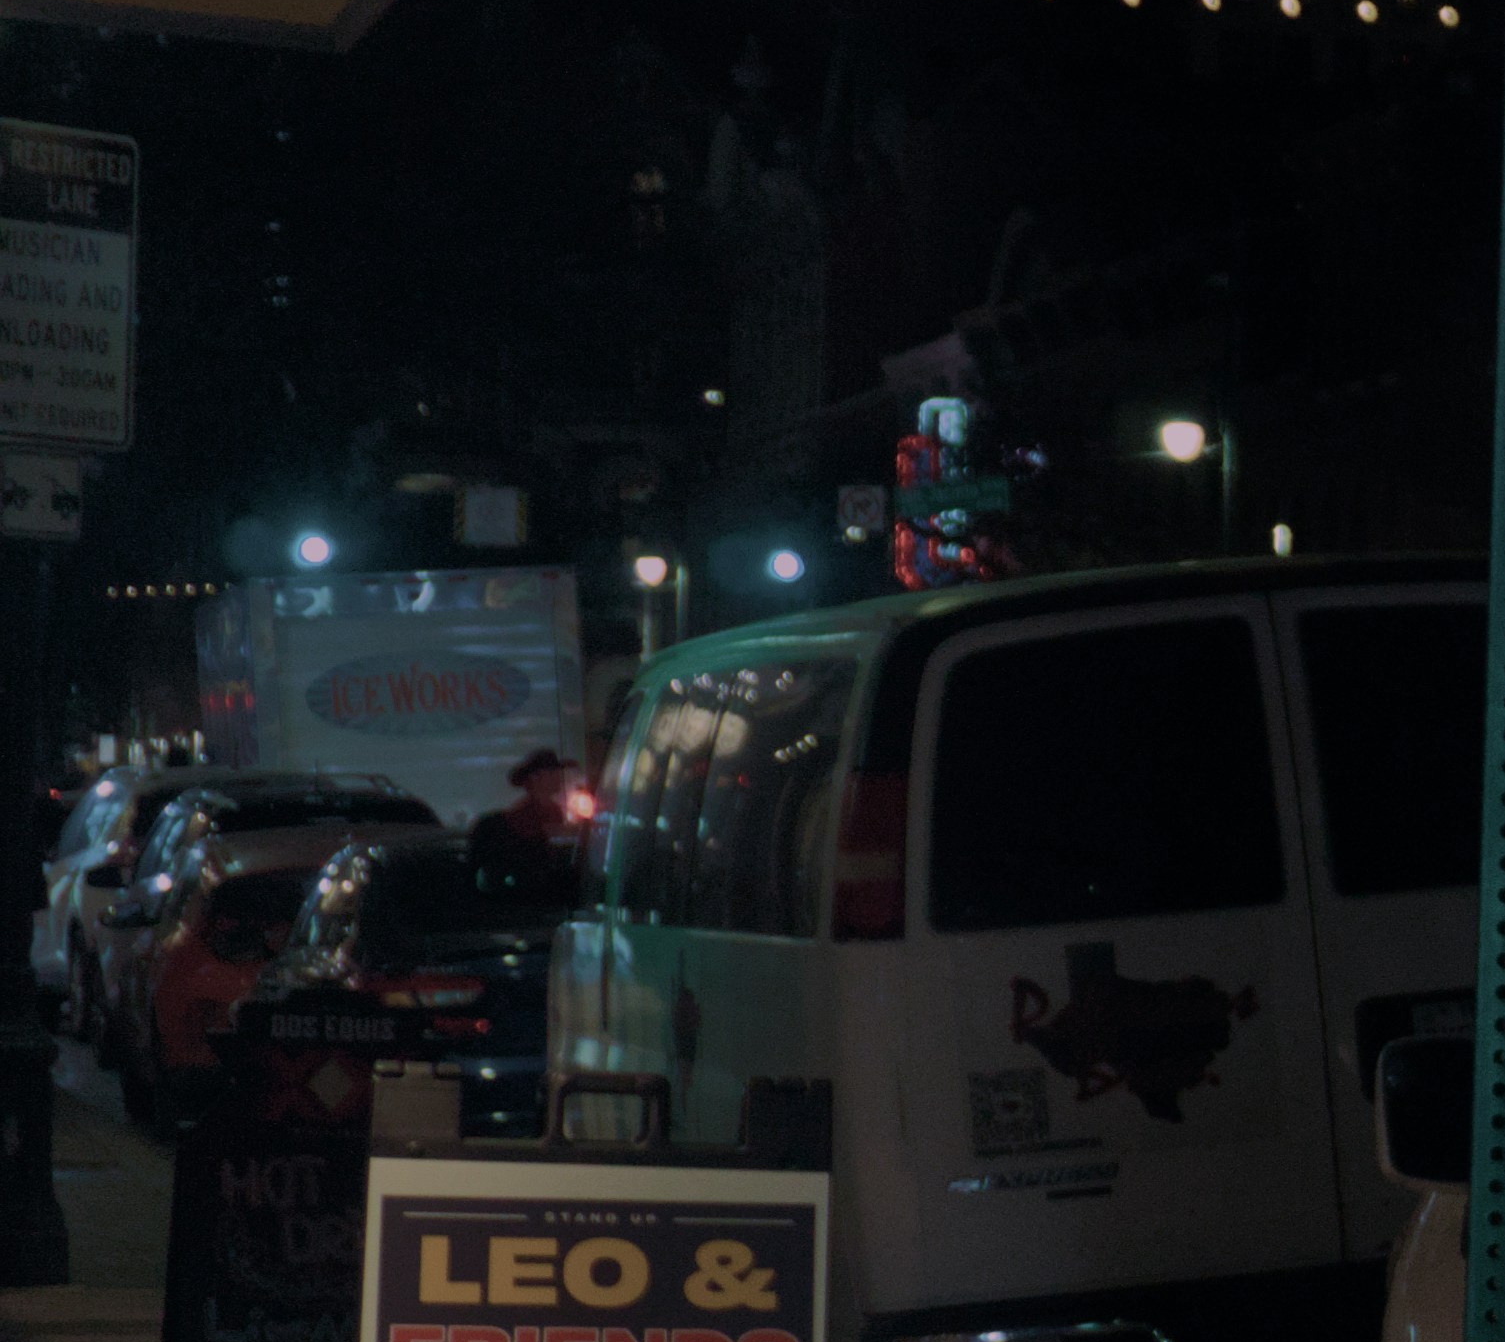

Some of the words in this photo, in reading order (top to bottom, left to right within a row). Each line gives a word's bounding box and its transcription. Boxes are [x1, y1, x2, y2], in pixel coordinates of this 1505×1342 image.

[11, 137, 131, 185] RESTRICTED
[48, 180, 99, 218] LANE
[78, 281, 122, 312] AND
[270, 1012, 319, 1039] DOS
[544, 1210, 619, 1225] STAND
[418, 1233, 652, 1309] LEO
[682, 1237, 780, 1313] &
